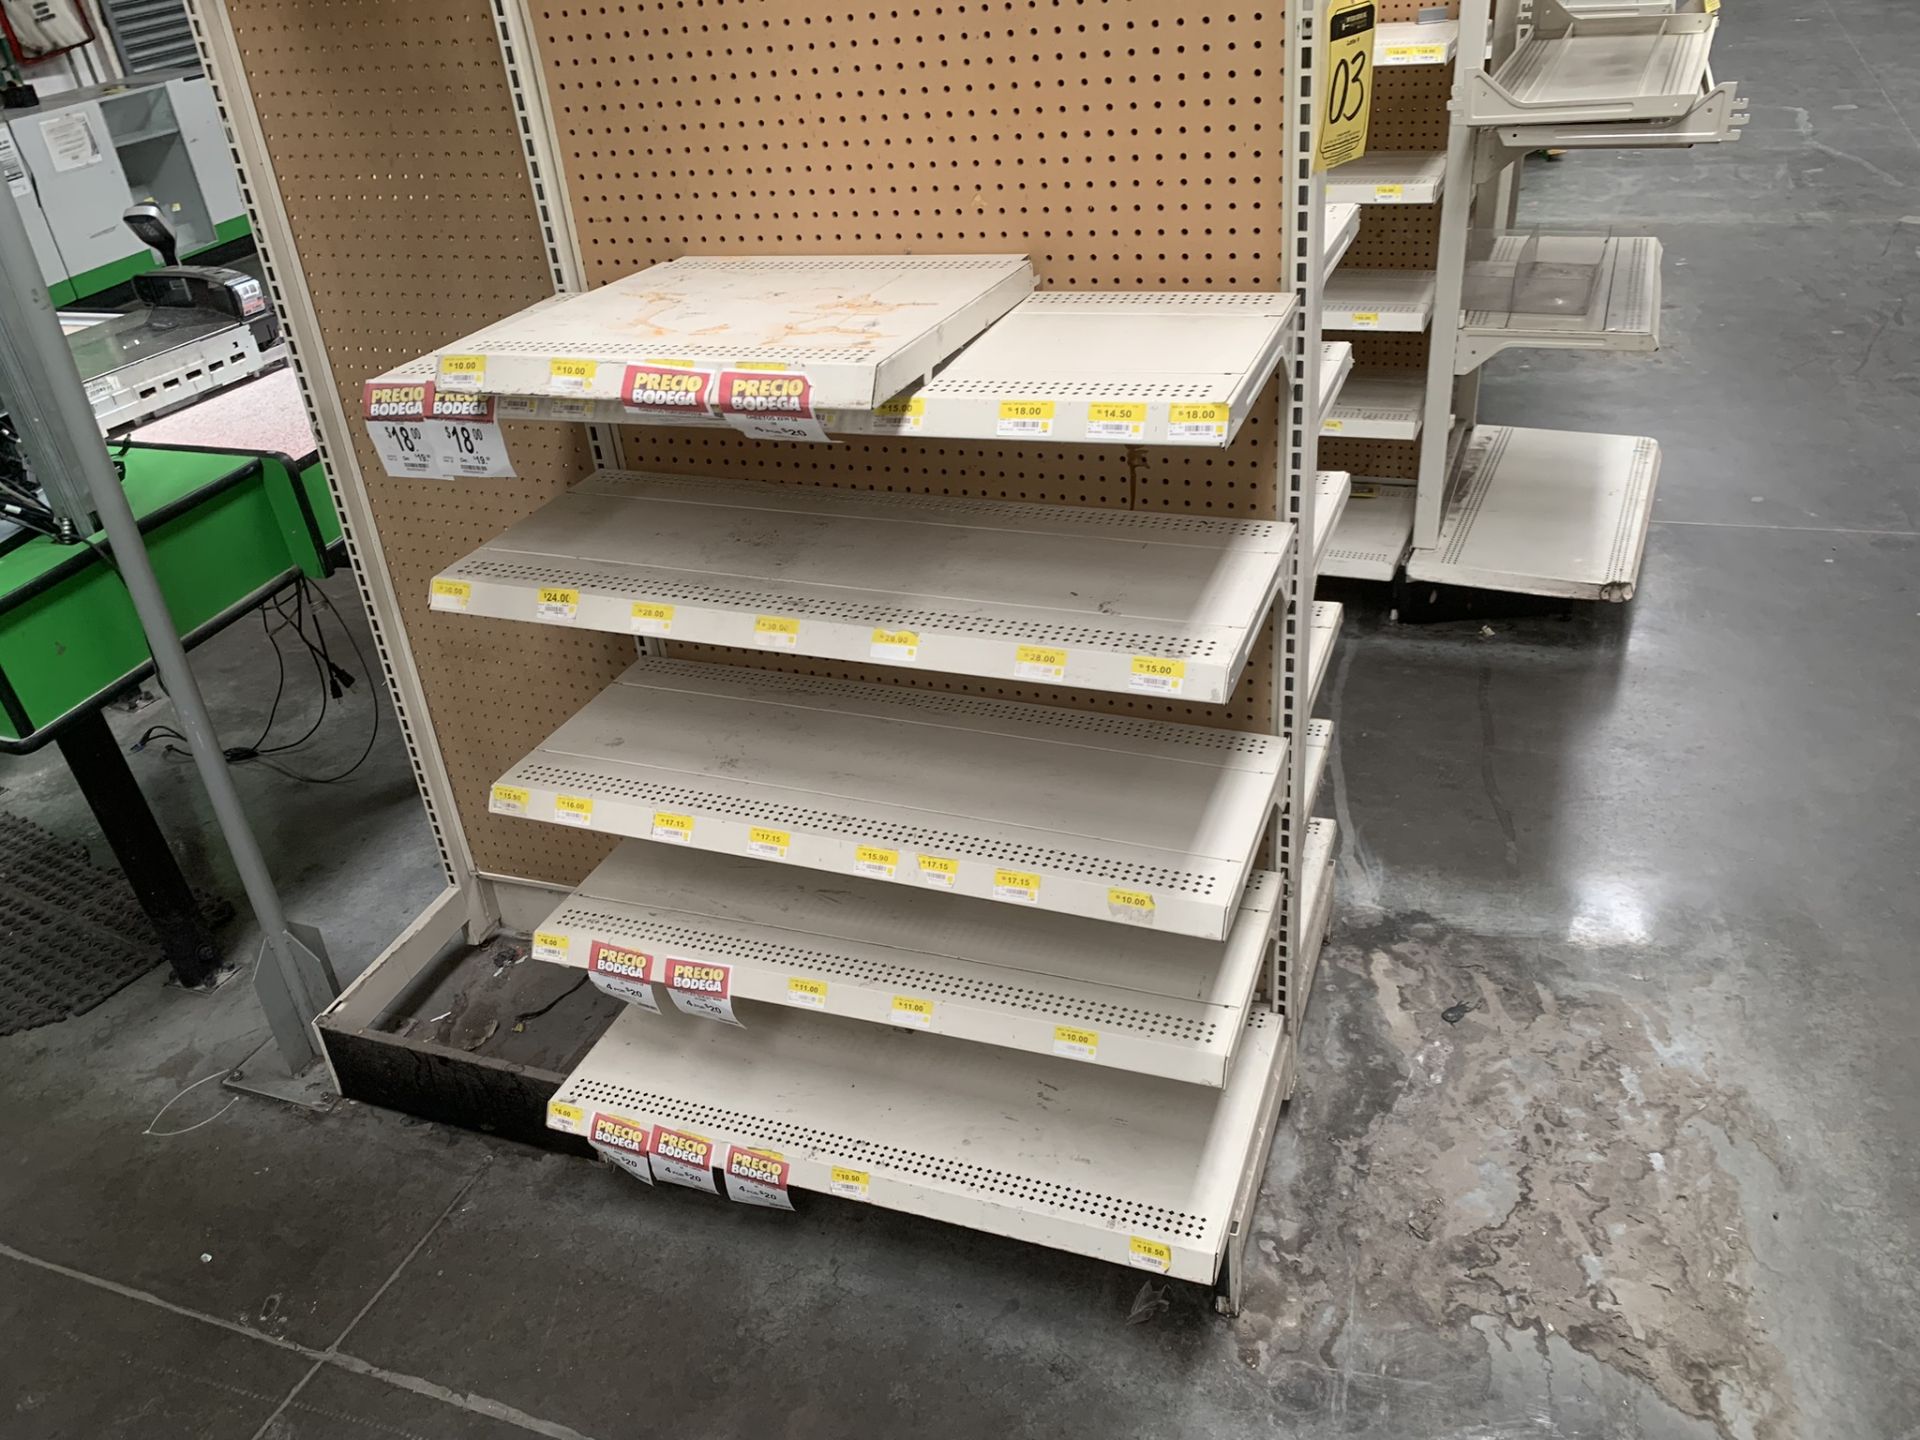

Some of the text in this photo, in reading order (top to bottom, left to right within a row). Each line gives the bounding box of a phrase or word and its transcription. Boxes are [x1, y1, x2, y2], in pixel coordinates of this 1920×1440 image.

[1329, 50, 1366, 125] 03
[633, 372, 703, 392] PRECIO
[732, 379, 804, 397] PRECIO
[371, 386, 425, 404] PRECIO
[632, 388, 697, 406] BODEGA
[730, 395, 801, 412] BODEGA
[370, 401, 423, 416] BODEGA
[432, 401, 488, 415] BODEGA
[598, 948, 647, 968] PRECIO
[597, 960, 644, 978] BODEGA
[674, 965, 725, 981] PRECIO
[673, 977, 722, 992] BODEGA
[596, 1119, 643, 1142] PRECIO
[595, 1131, 640, 1151] BODEGA
[660, 1132, 707, 1156] PRECIO
[658, 1143, 704, 1165] BODEGA
[732, 1152, 782, 1175] PRECIO
[731, 1164, 780, 1185] BODEGA
